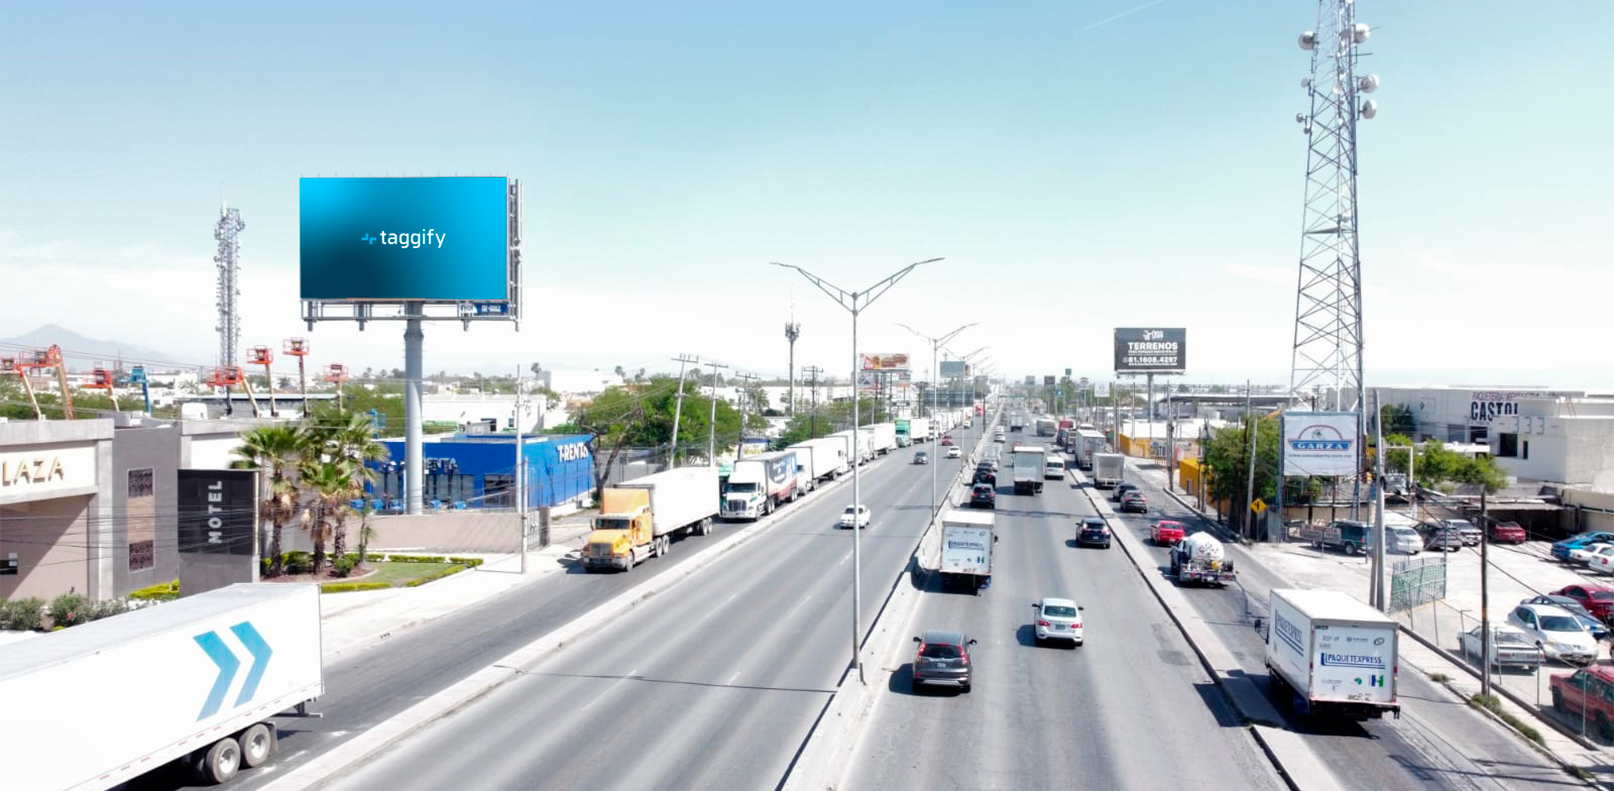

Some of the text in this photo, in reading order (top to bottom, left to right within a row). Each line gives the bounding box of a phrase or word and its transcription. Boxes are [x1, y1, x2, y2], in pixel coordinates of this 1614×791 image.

[380, 228, 446, 249] taggify
[1127, 342, 1178, 350] TERRENOS
[208, 480, 223, 545] MOTEL
[1328, 654, 1382, 664] PAQUETEXPRESS
